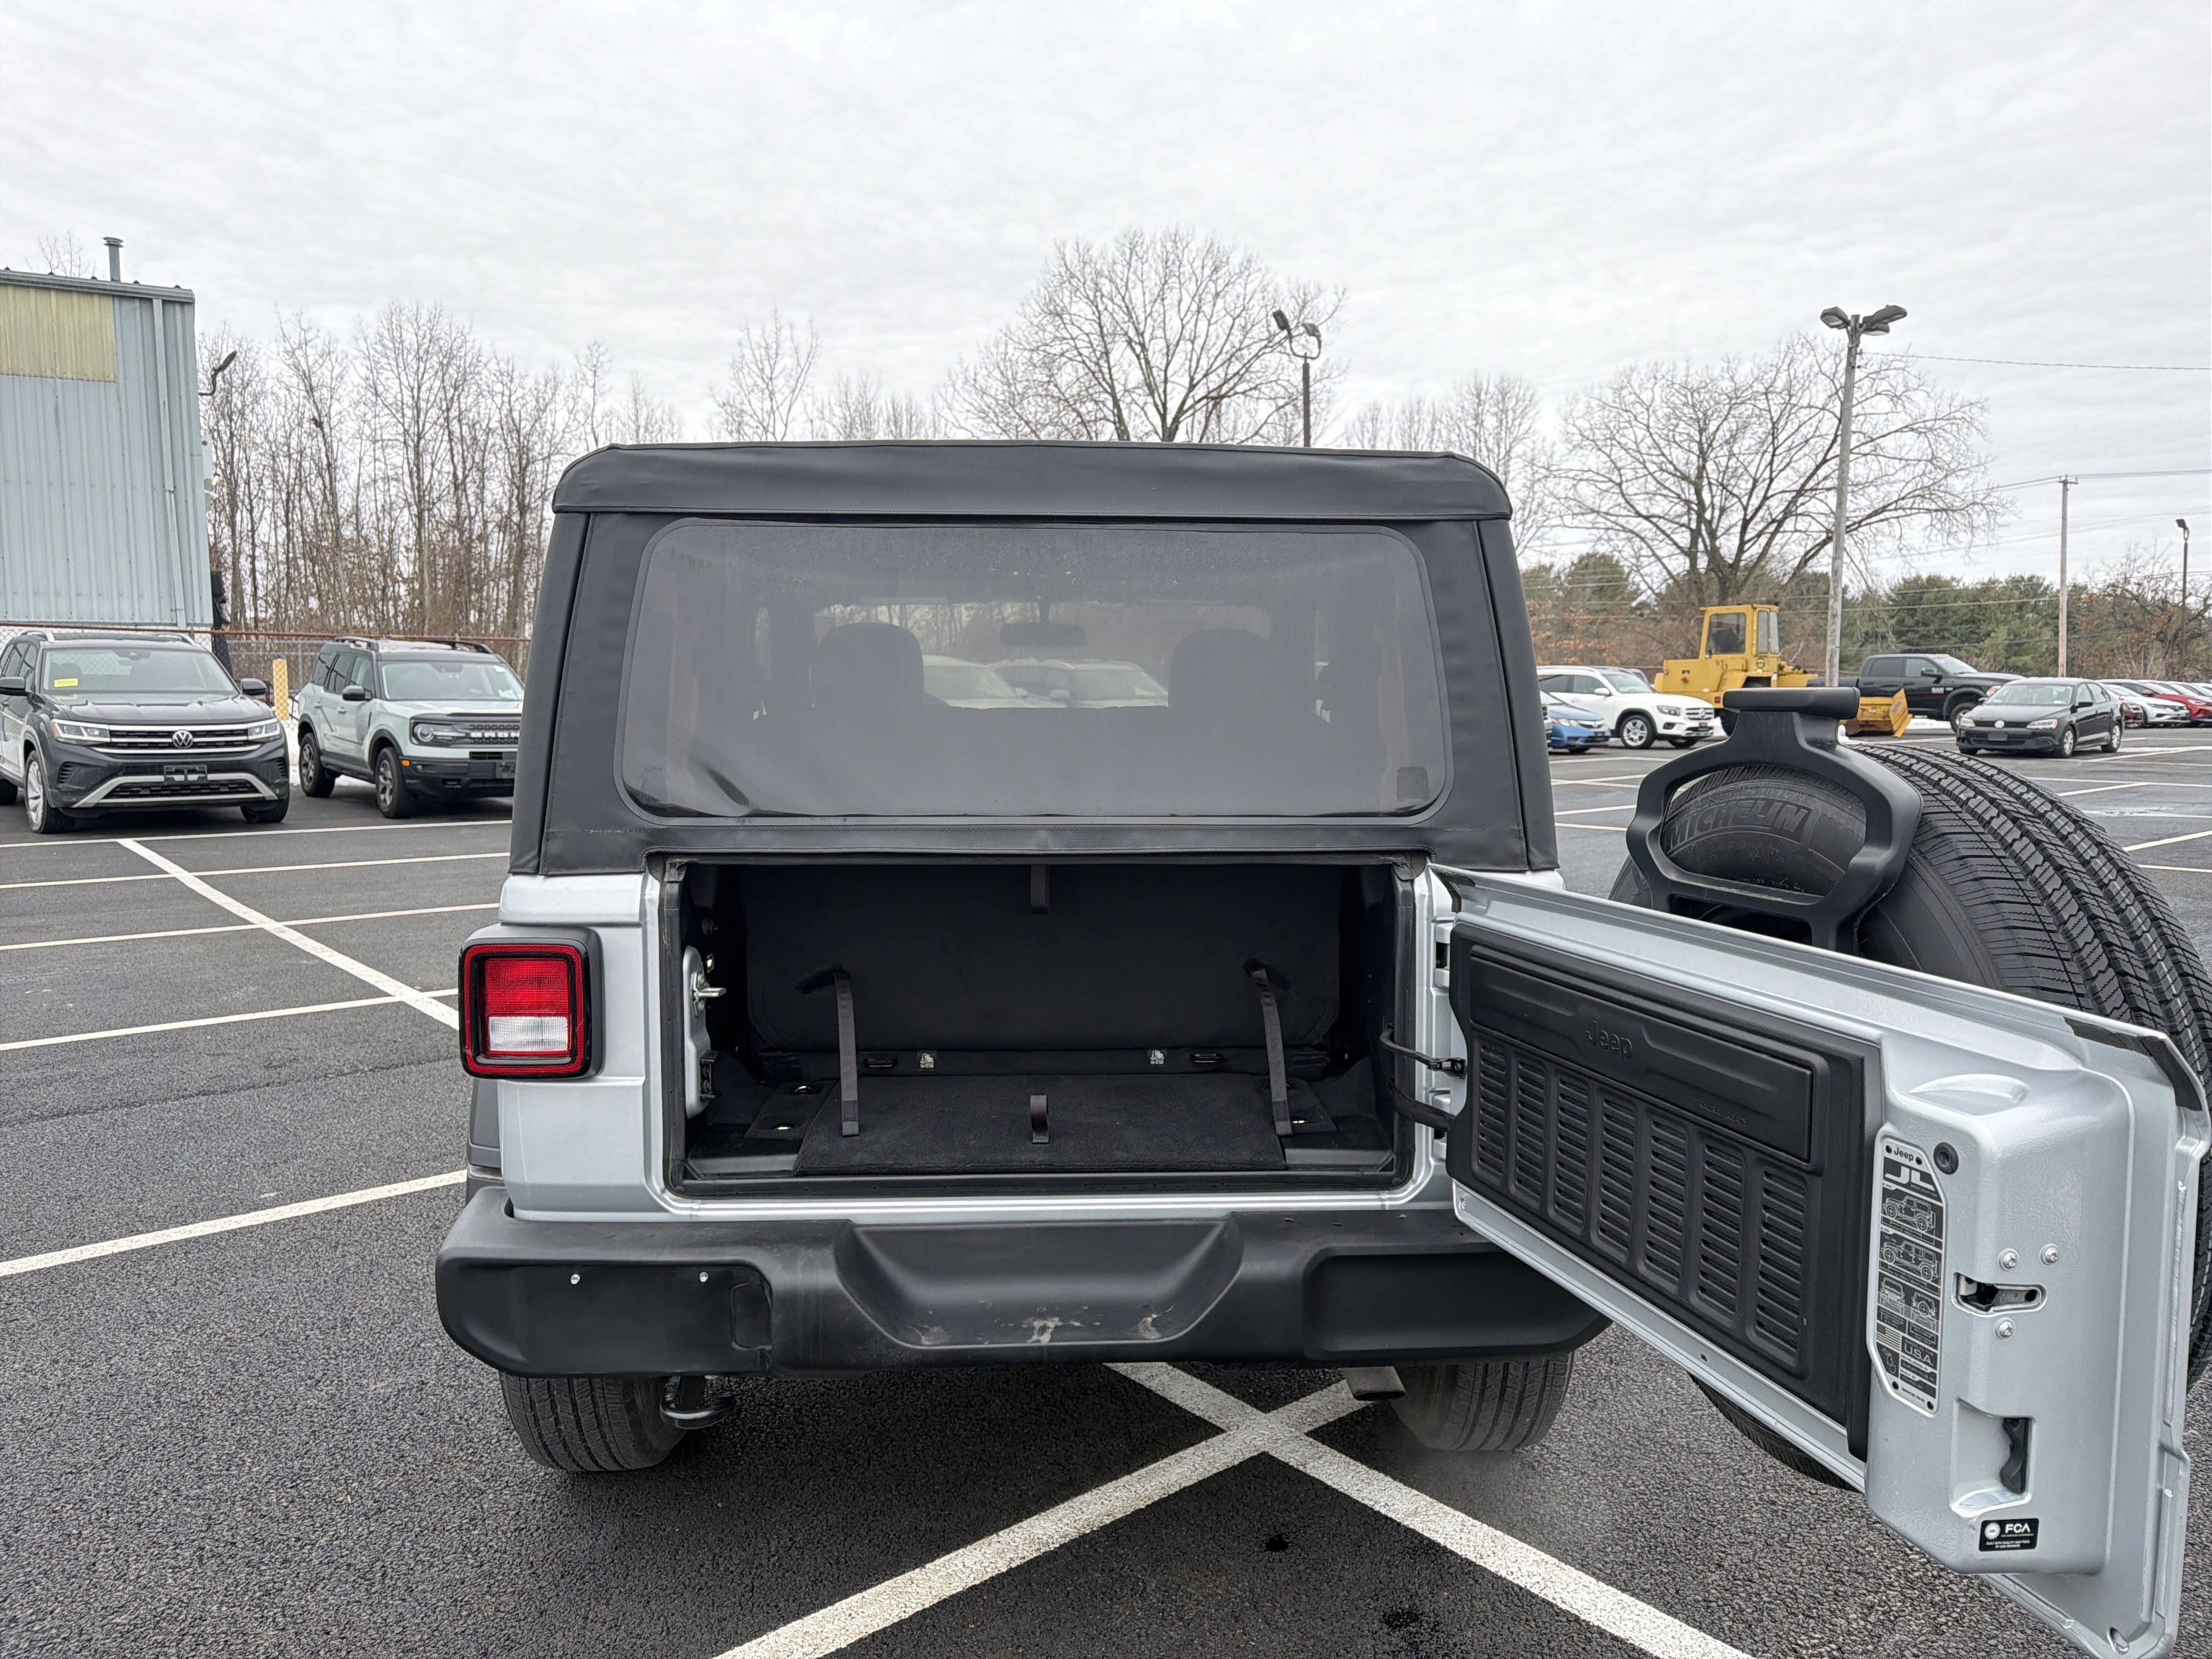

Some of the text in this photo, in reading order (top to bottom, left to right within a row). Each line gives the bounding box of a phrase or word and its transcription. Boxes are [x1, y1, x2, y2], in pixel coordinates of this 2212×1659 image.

[1668, 799, 1809, 850] MICHELIN
[1585, 1020, 1633, 1062] Jeep
[1893, 1147, 1914, 1162] Jeep
[1884, 1166, 1936, 1192] JL
[1904, 1343, 1934, 1367] U.S.A.
[2005, 1523, 2030, 1533] FCA
